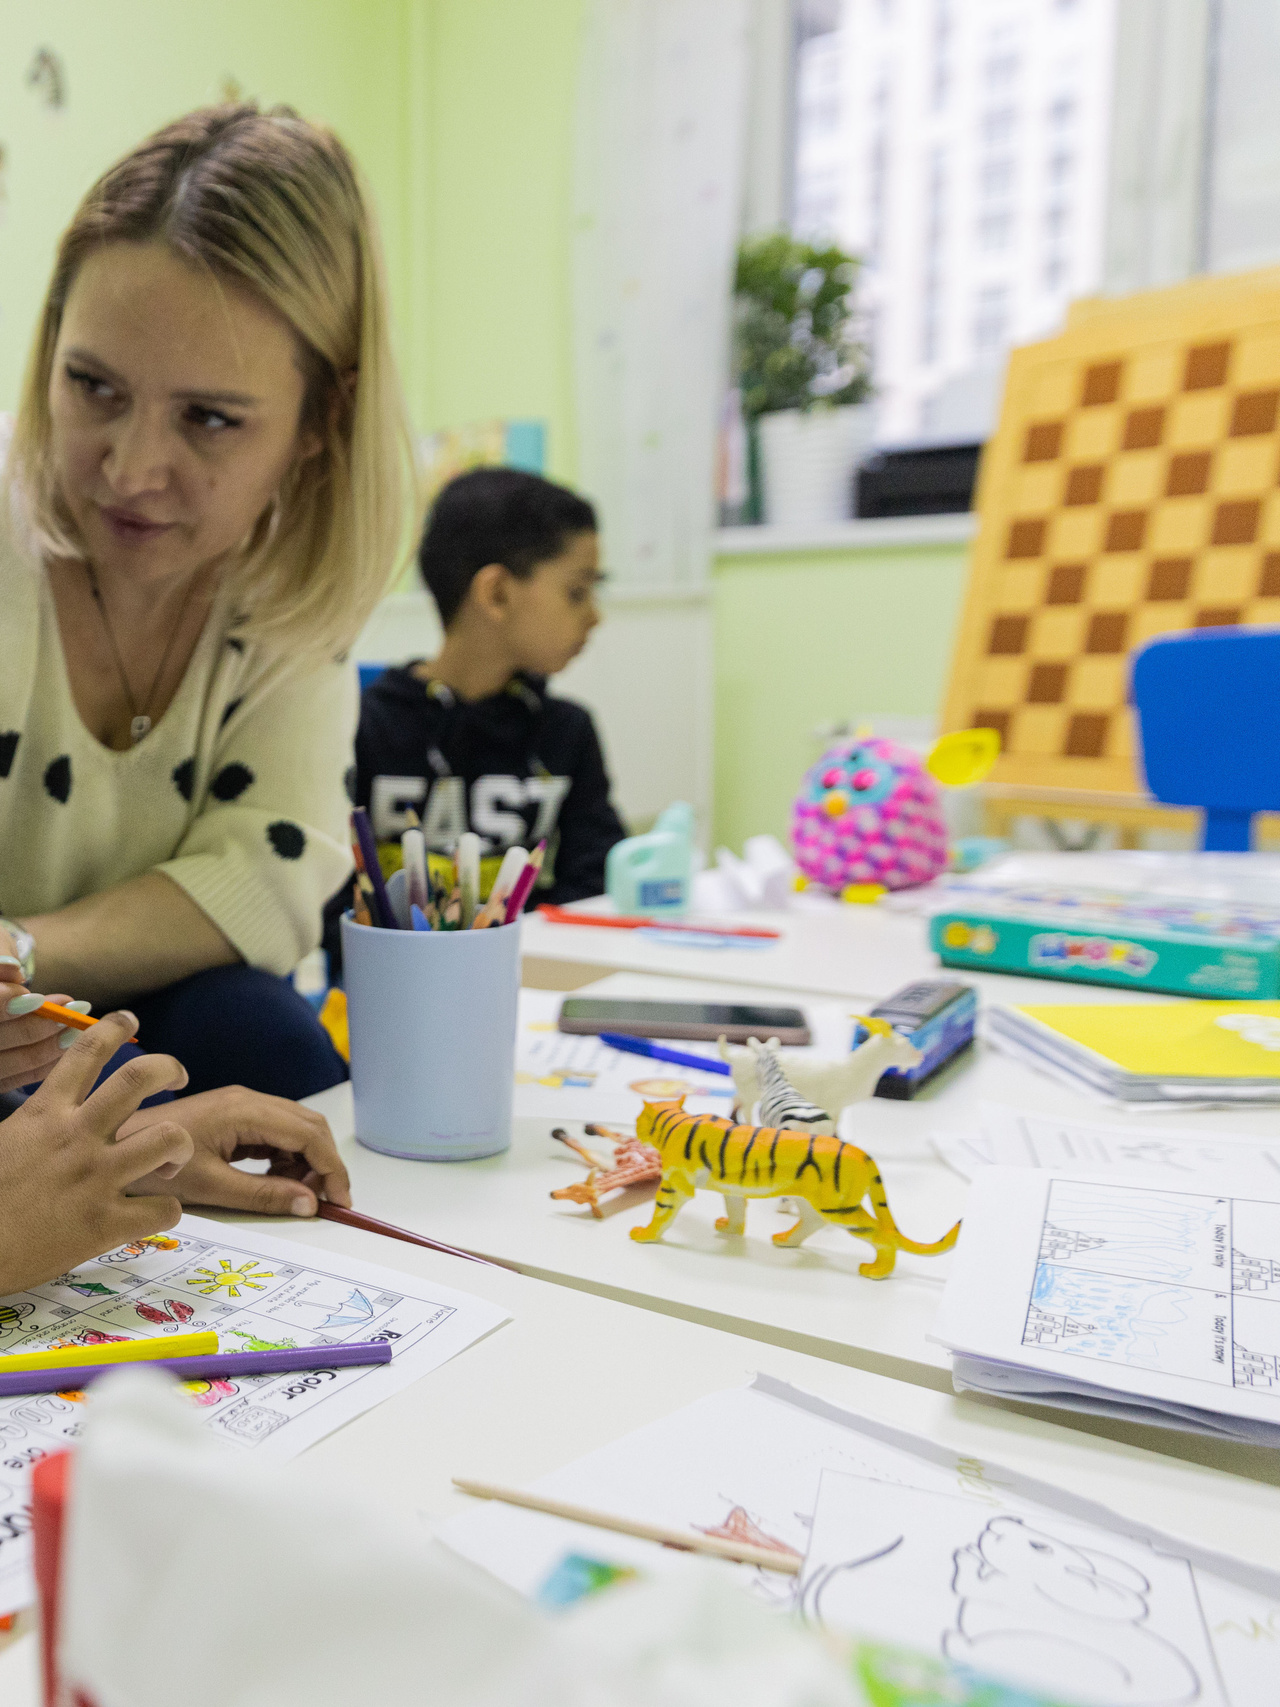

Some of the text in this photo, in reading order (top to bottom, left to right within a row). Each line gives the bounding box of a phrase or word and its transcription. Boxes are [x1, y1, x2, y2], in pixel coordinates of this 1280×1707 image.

[1212, 1224, 1226, 1242] Today
[1212, 1315, 1226, 1334] Today
[280, 1369, 337, 1401] Color
